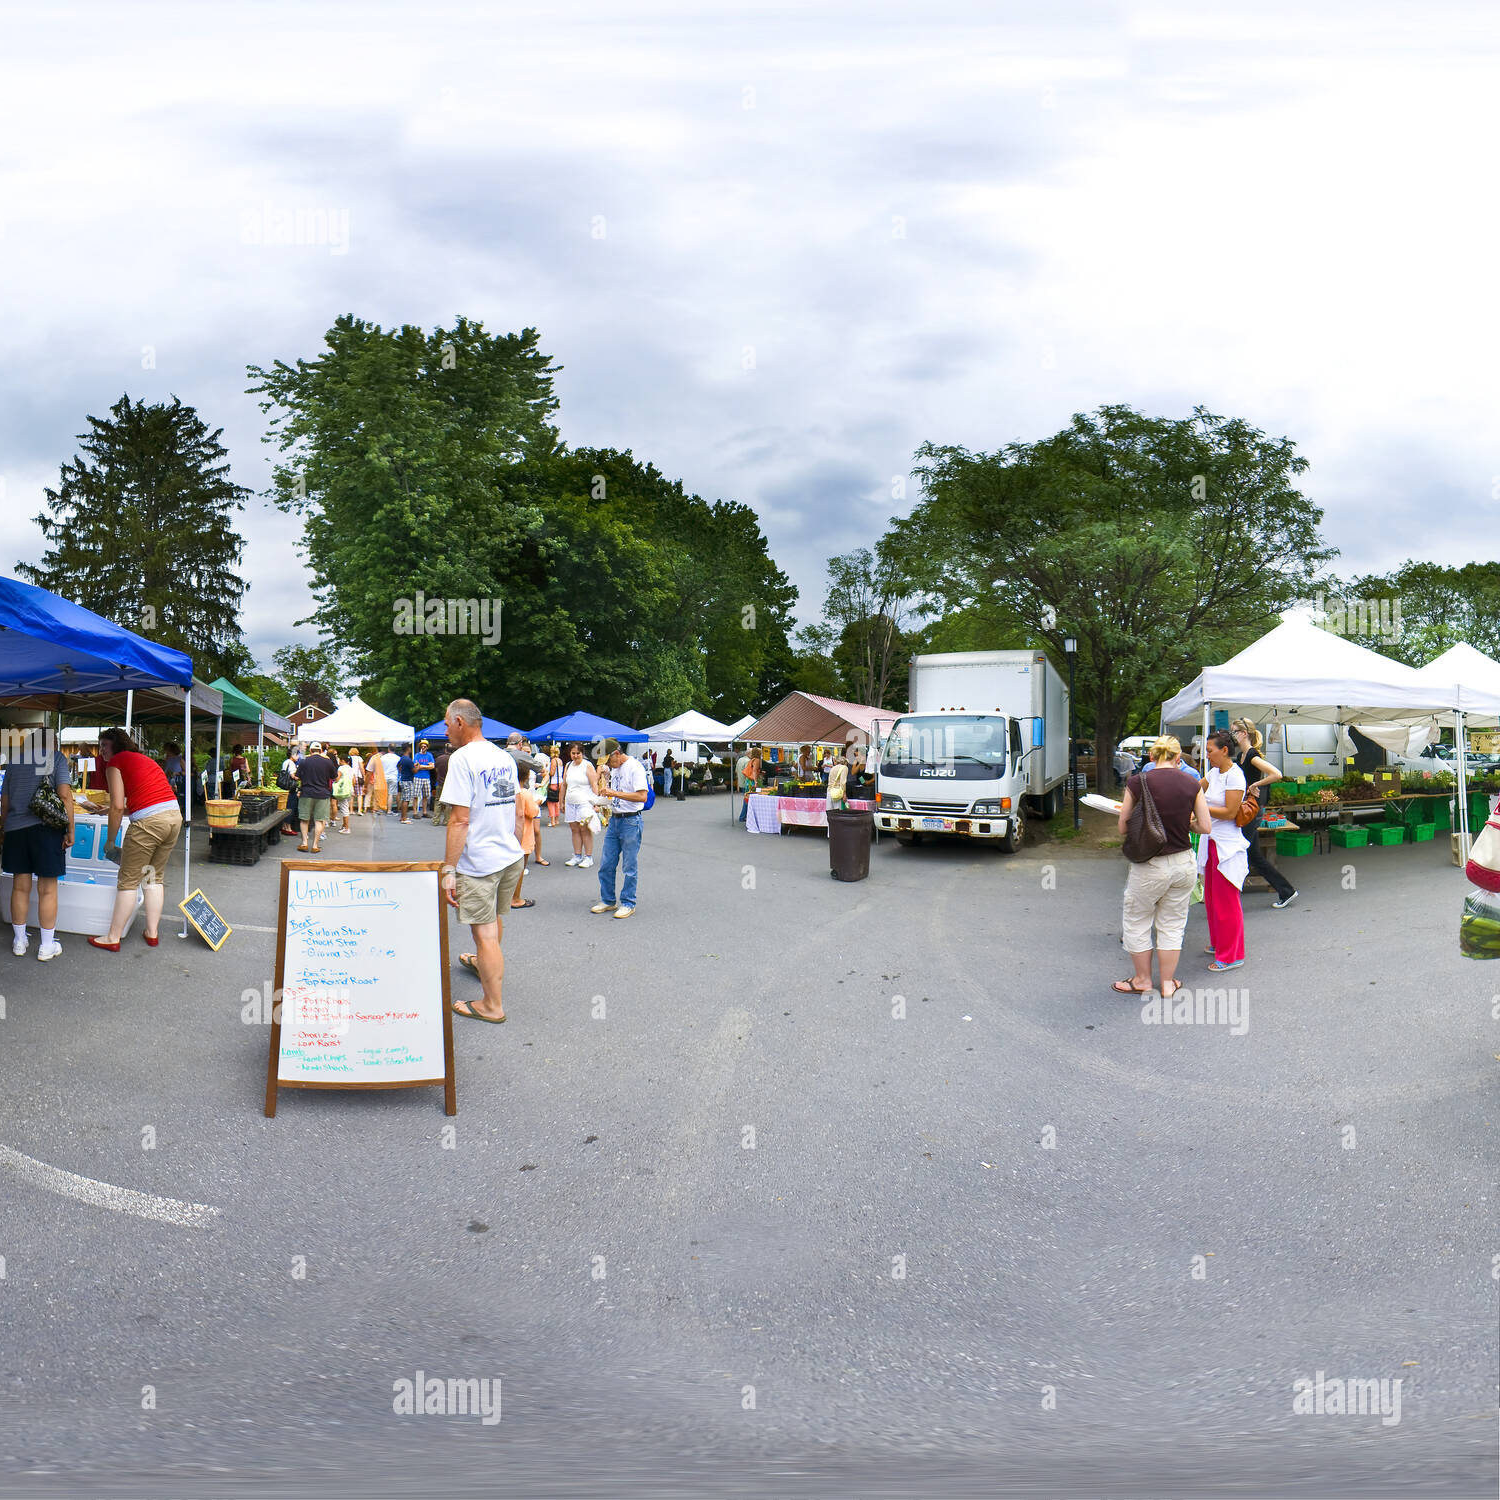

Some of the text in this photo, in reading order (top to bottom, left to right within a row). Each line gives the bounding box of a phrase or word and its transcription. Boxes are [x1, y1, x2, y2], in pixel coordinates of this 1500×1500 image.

[919, 769, 956, 777] ISUZU
[295, 878, 387, 904] Uphill Farm
[349, 976, 380, 985] Roast
[318, 1039, 341, 1048] Roast
